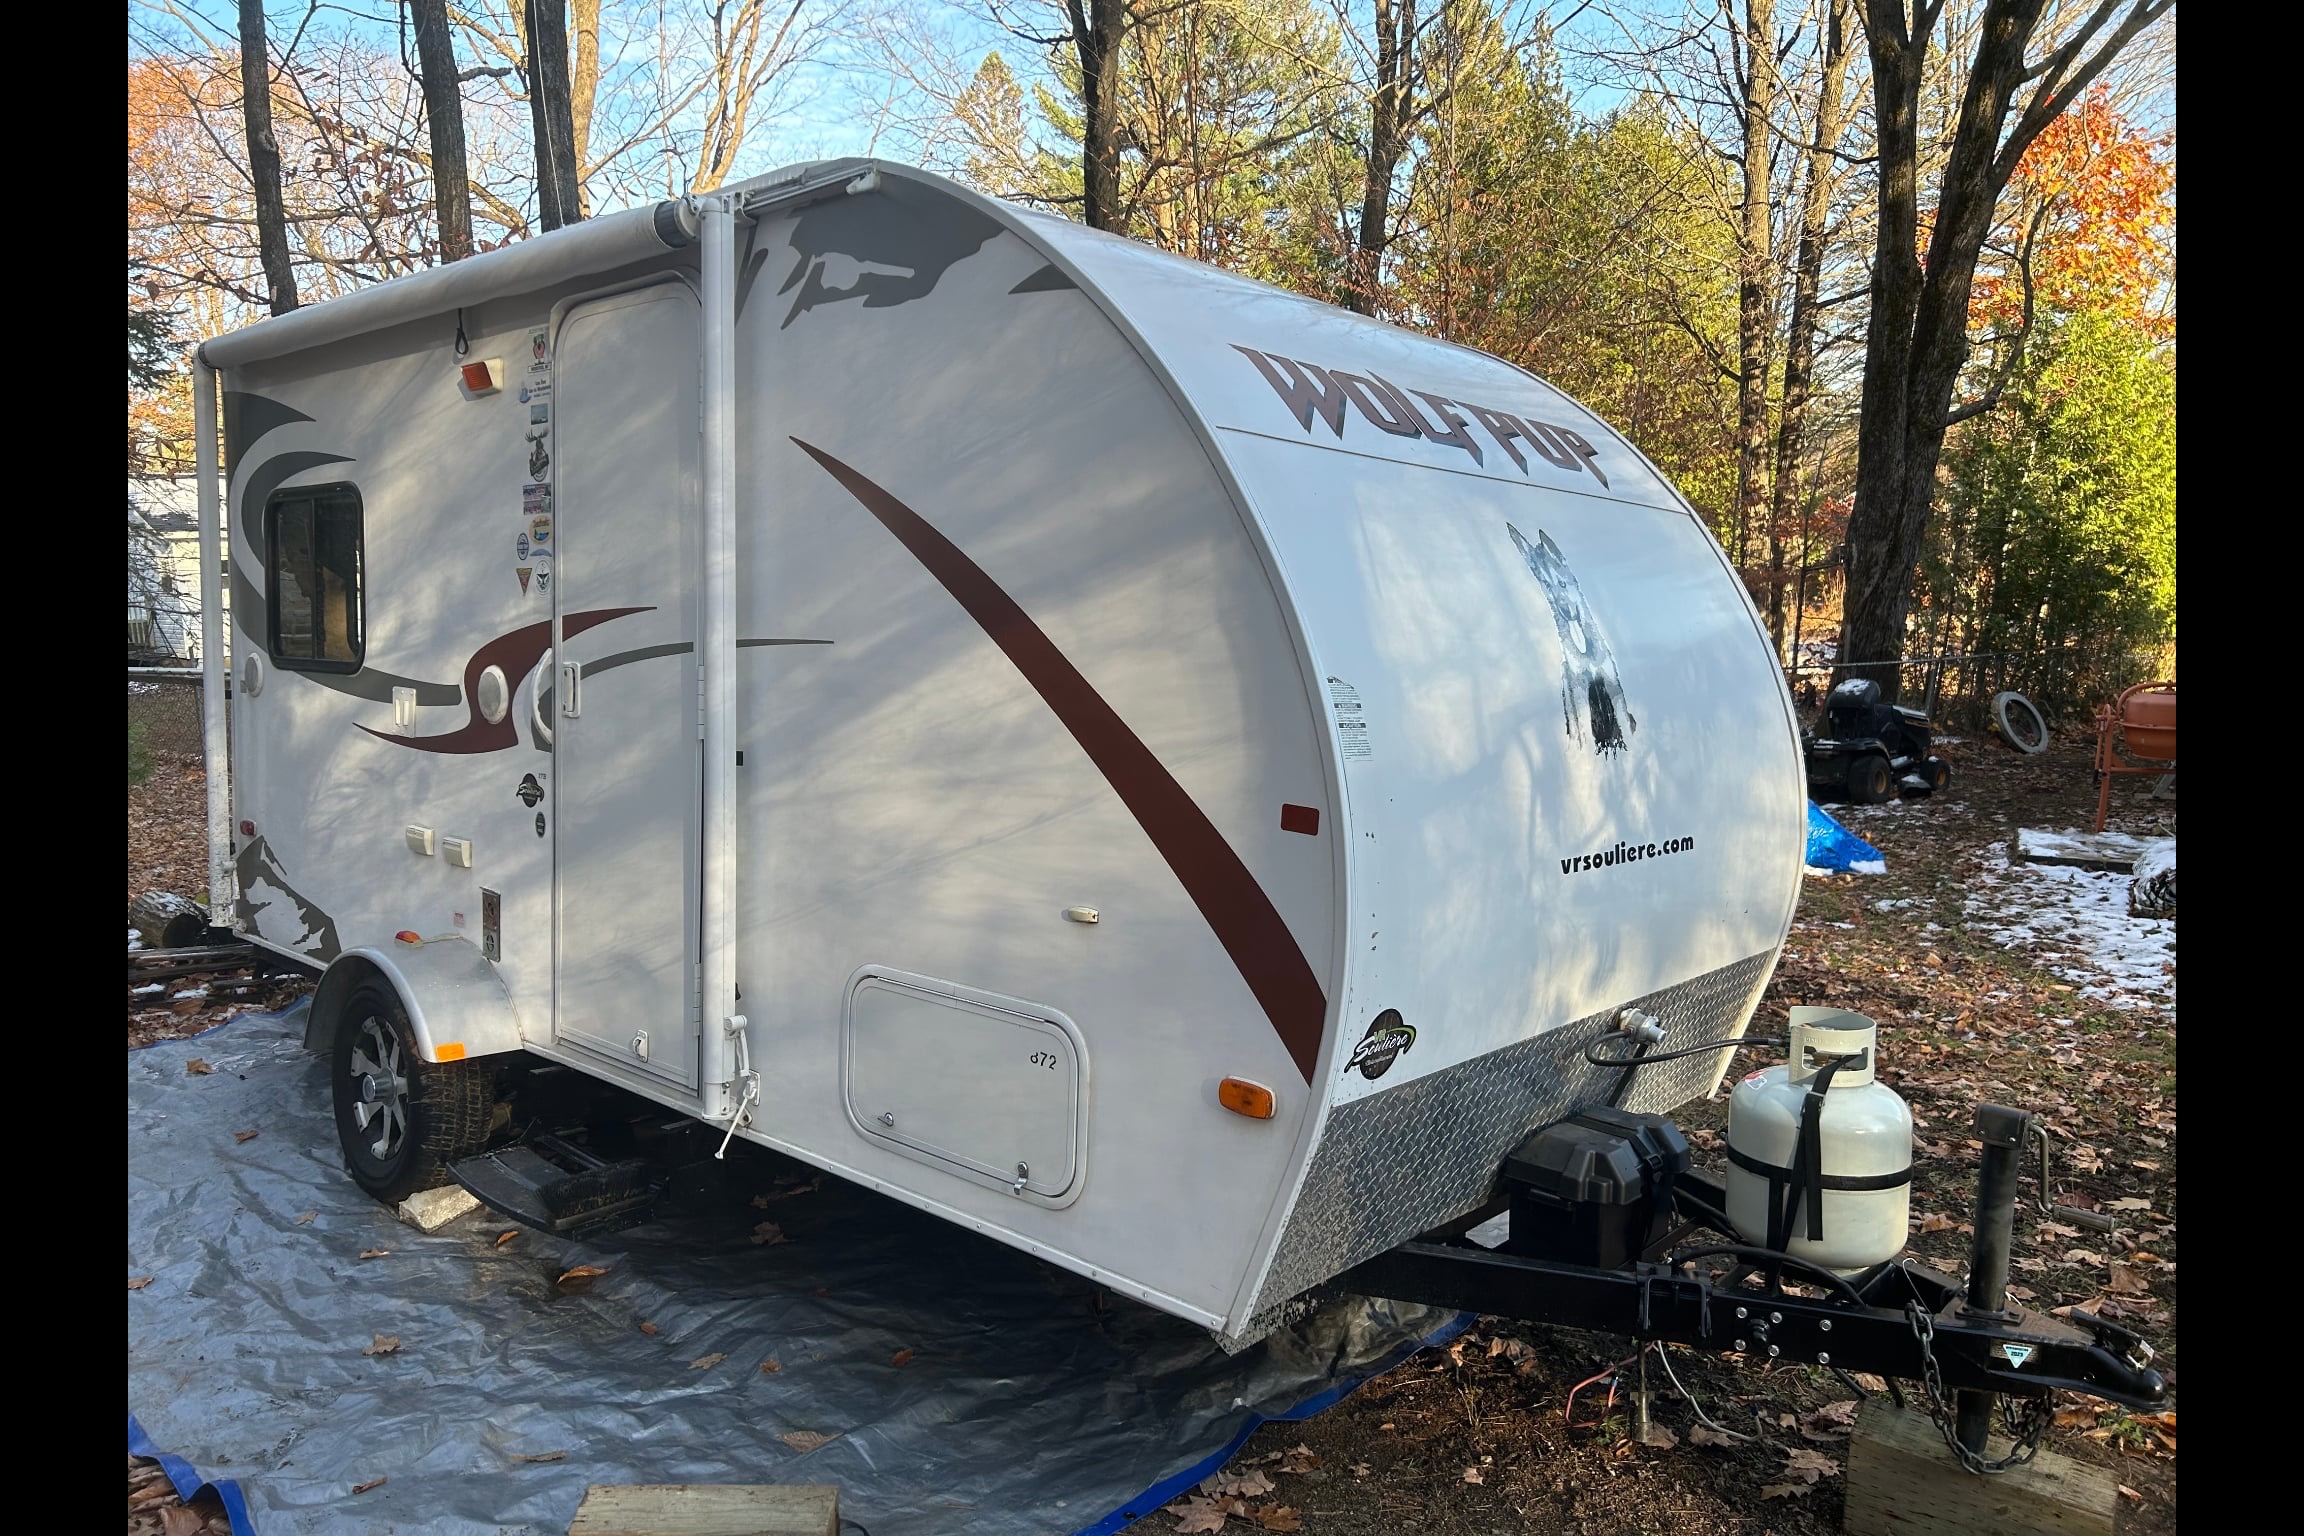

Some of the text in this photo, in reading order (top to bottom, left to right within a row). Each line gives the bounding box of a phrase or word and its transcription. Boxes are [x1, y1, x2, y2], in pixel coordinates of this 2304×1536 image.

[1228, 342, 1610, 492] WOLF PUP
[1560, 835, 1694, 875] vrsouliere.com
